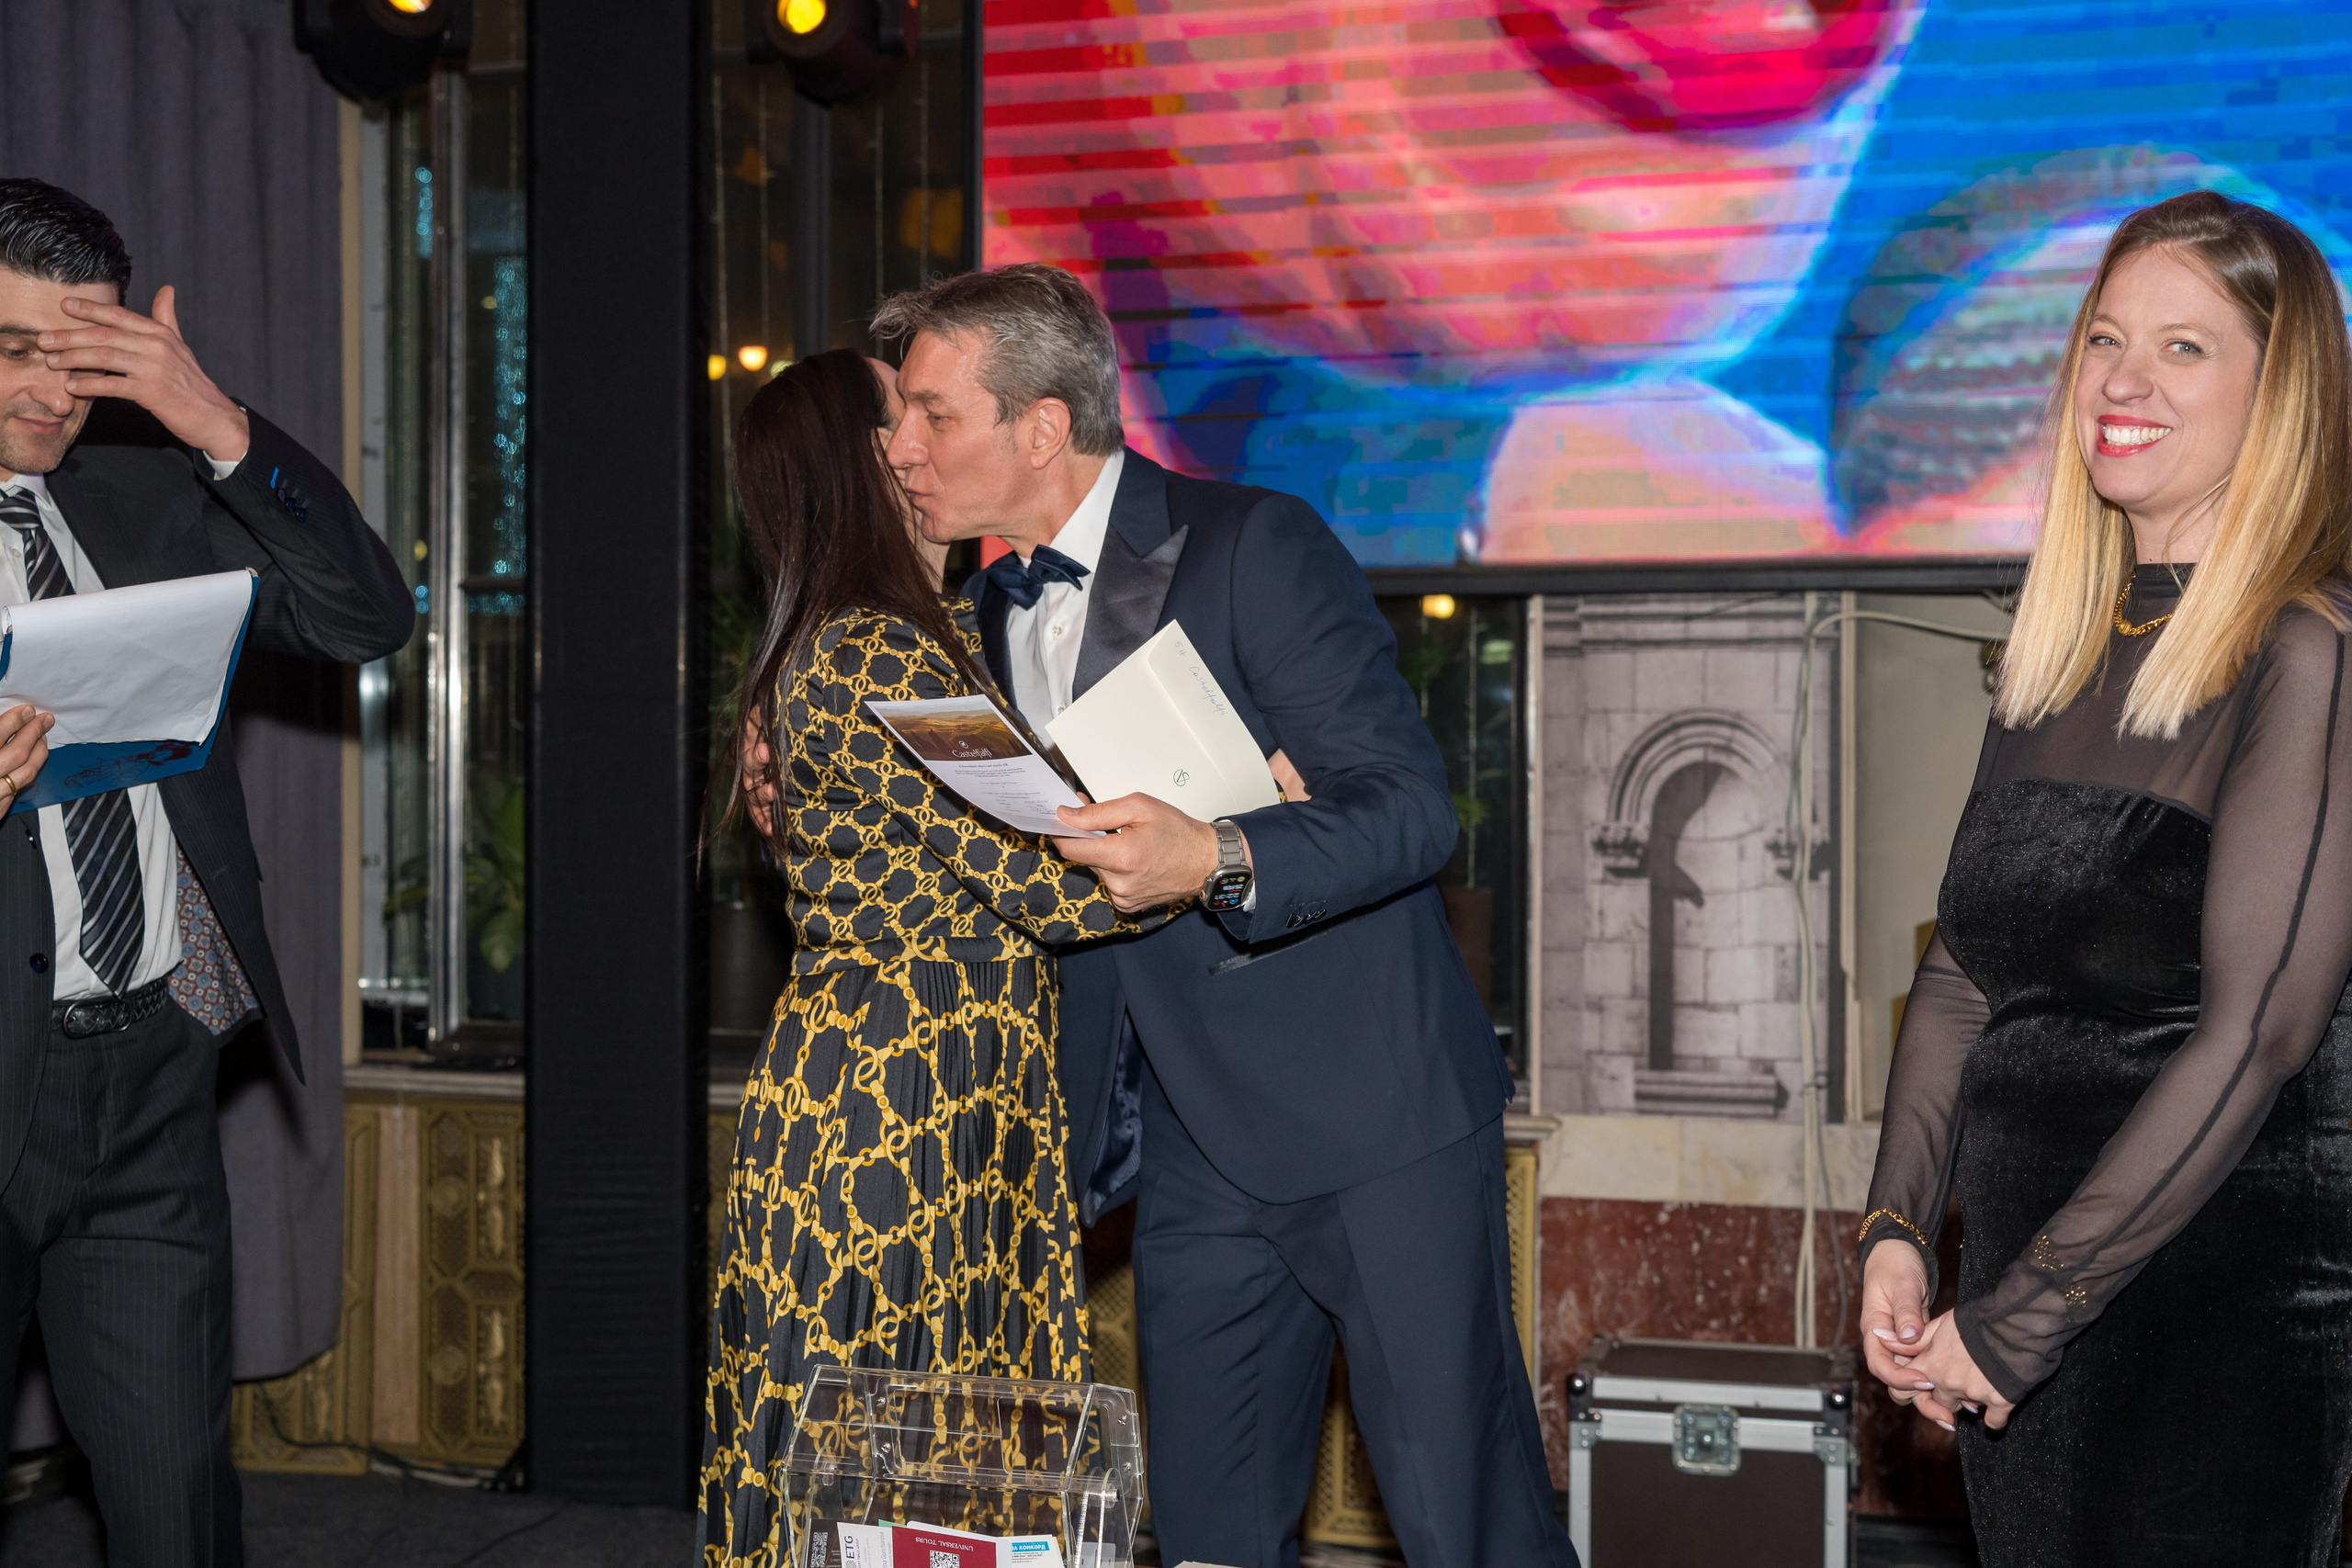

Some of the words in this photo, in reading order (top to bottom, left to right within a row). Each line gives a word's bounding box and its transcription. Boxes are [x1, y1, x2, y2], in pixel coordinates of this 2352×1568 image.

[952, 748, 993, 760] Castelfalfi
[915, 1536, 937, 1546] TOURS
[938, 1540, 974, 1551] UNIVERSAL
[844, 1535, 854, 1559] ETG
